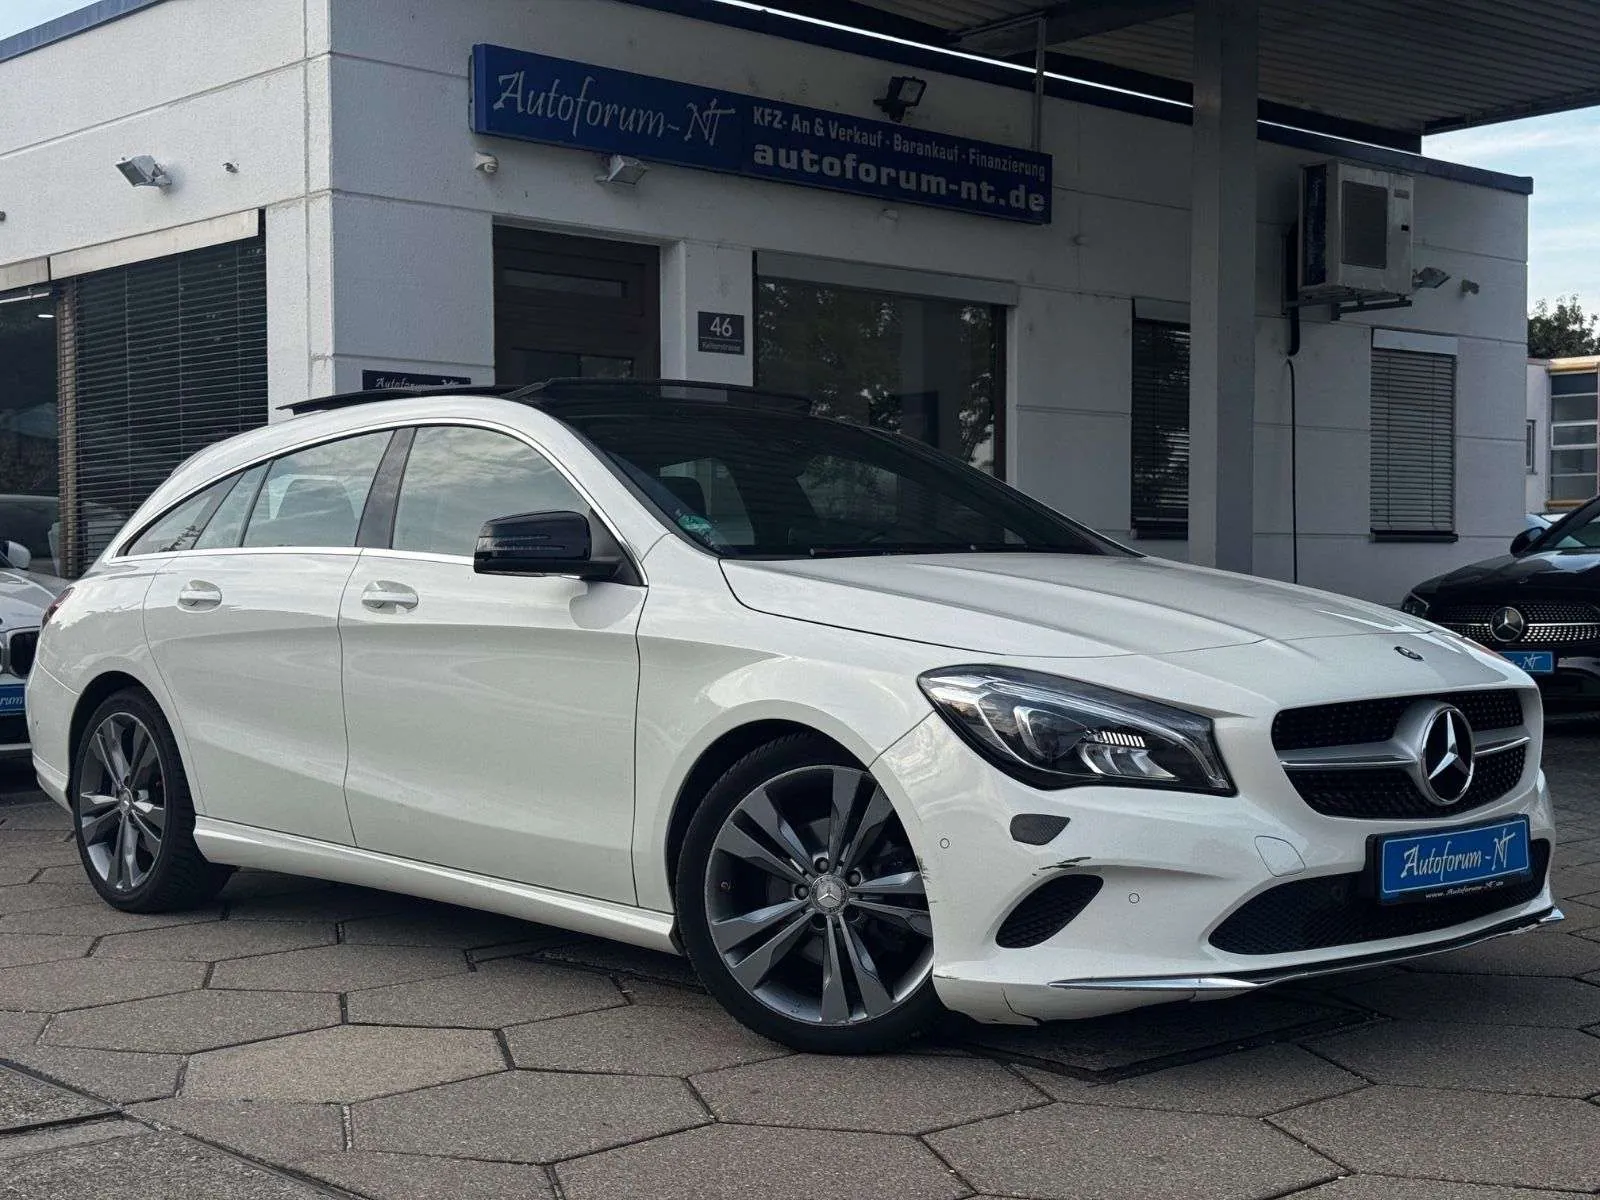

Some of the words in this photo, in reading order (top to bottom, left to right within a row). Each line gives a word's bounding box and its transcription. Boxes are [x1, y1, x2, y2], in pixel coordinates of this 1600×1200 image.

[492, 70, 736, 147] Autoforum-NT
[753, 143, 1046, 212] autoforum-nt.de
[791, 113, 811, 135] An
[814, 117, 825, 137] &
[828, 119, 883, 148] Verkauf
[893, 133, 959, 164] Barankauf
[968, 147, 1046, 182] Finanzierung
[710, 316, 732, 337] 46
